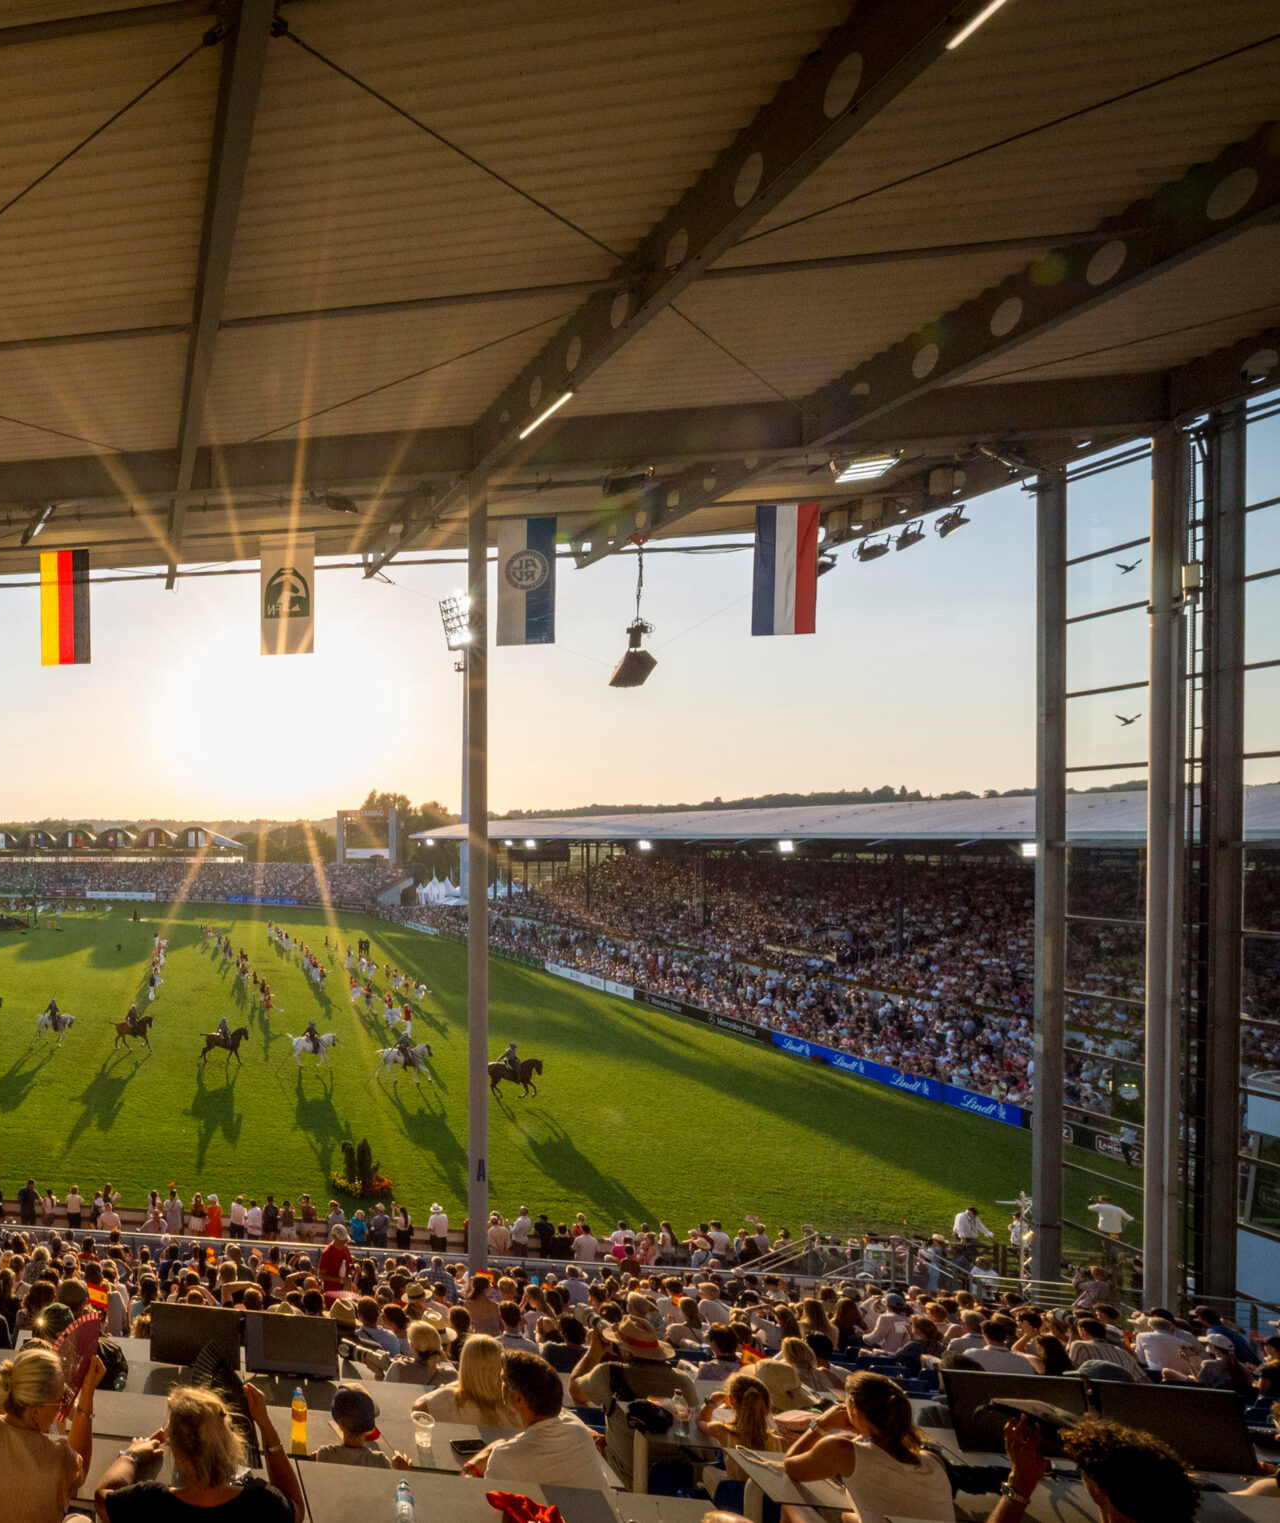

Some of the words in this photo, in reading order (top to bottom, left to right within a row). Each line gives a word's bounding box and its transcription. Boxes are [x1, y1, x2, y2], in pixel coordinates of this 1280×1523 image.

[717, 1018, 756, 1037] Mercedes-Benz
[782, 1038, 805, 1053] Lindt
[832, 1054, 857, 1070] Lindt
[890, 1073, 921, 1091] Lindt
[960, 1094, 997, 1115] Lindt
[477, 1159, 486, 1181] A
